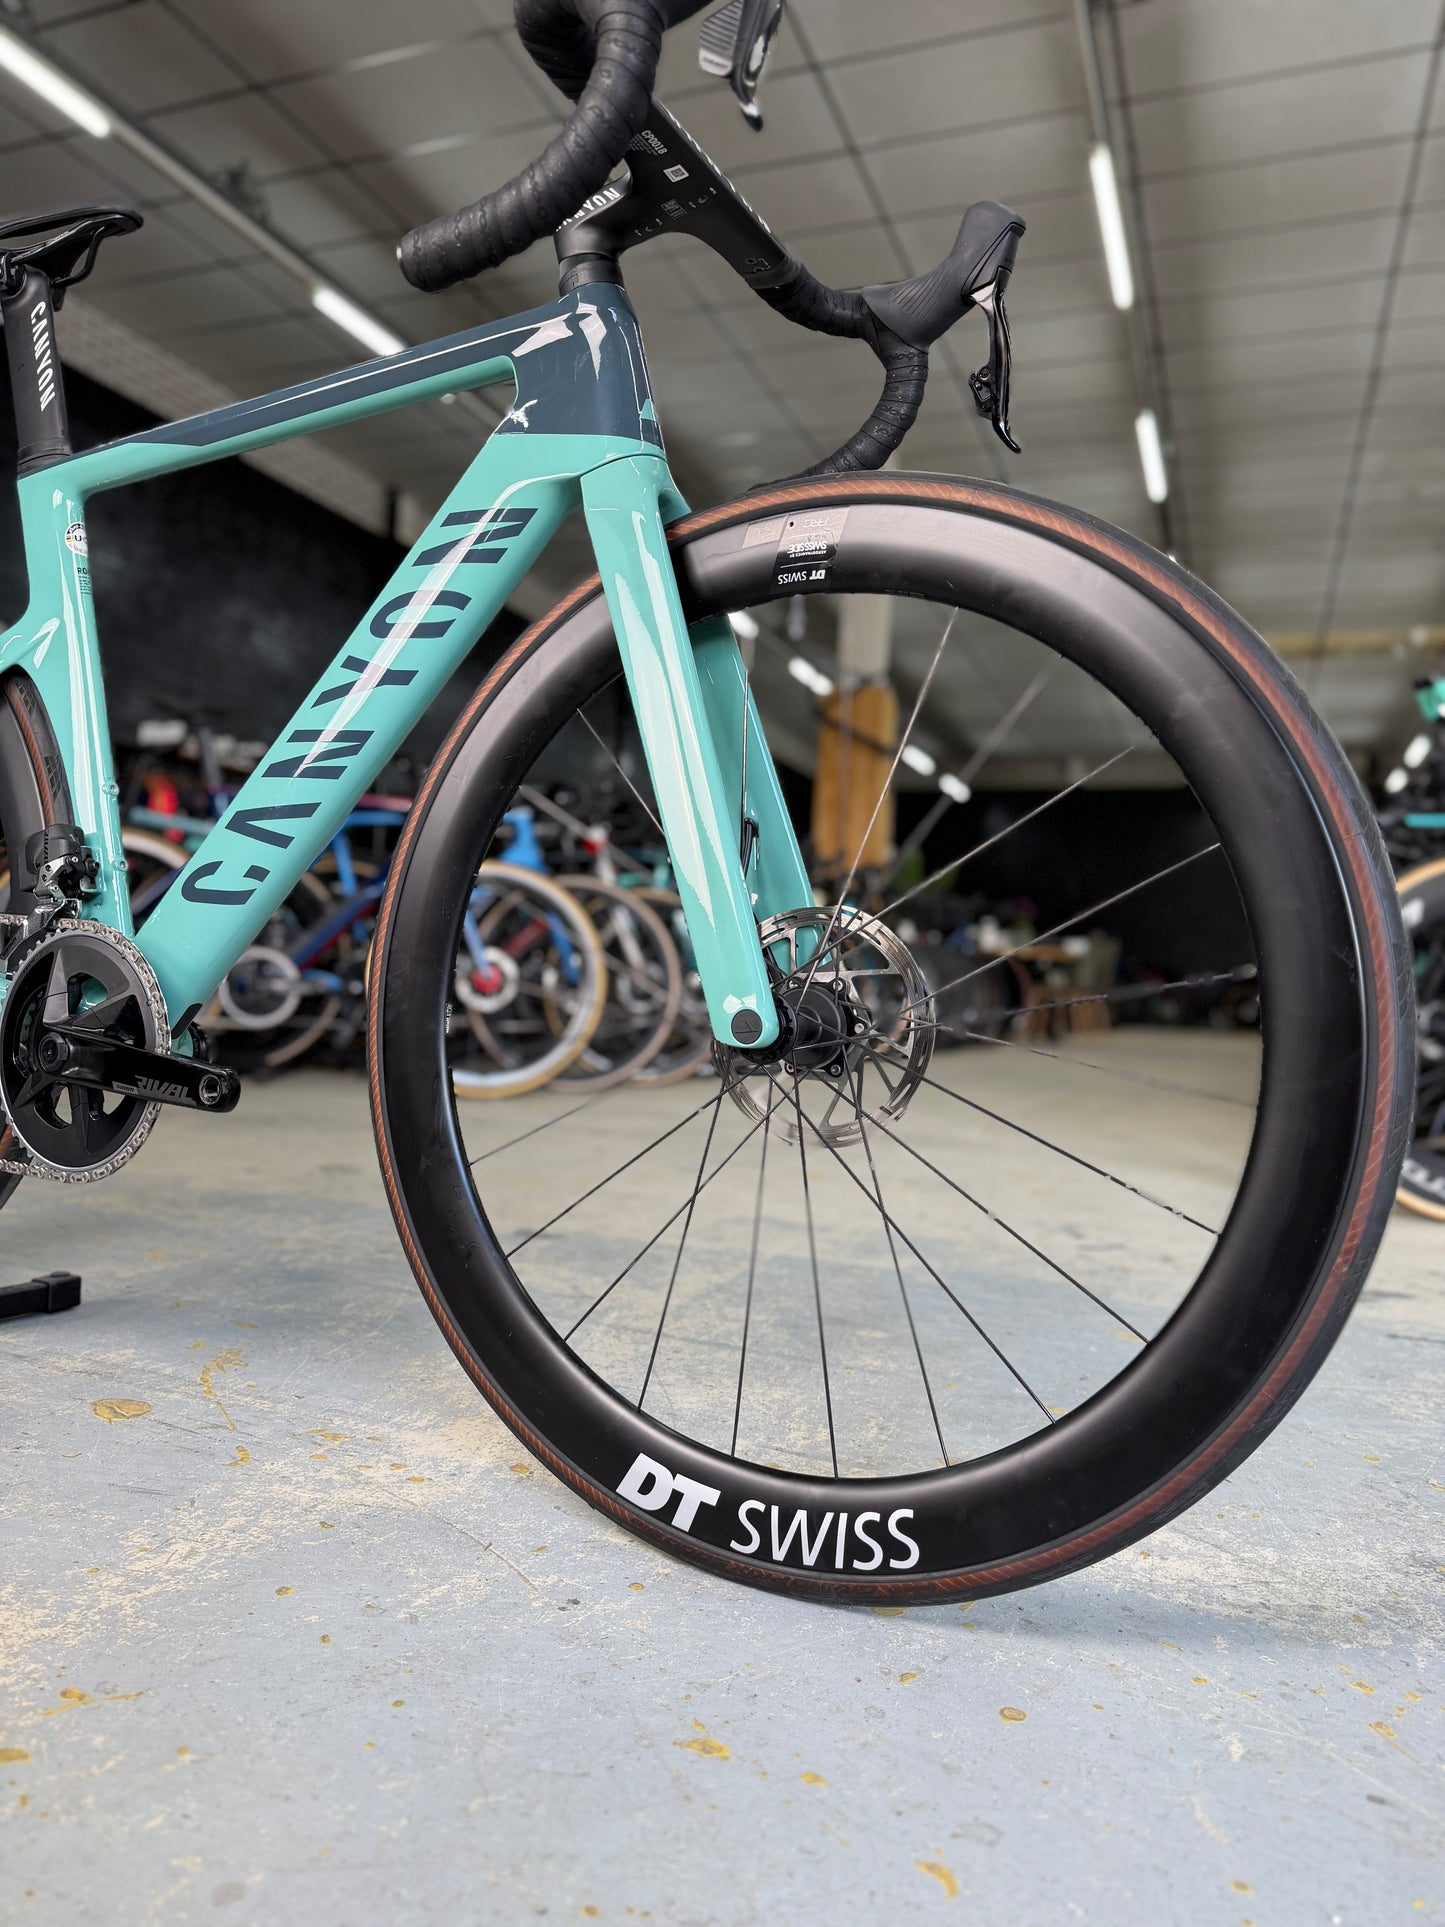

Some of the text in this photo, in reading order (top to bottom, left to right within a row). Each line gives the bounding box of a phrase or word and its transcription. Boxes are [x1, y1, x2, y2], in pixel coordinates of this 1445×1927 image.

[641, 130, 667, 154] CP0018
[555, 187, 621, 232] YON
[31, 301, 55, 412] CANYON
[778, 569, 826, 585] DT SWISS
[181, 508, 539, 906] CANYON
[135, 1075, 194, 1103] RIVAL
[615, 1452, 920, 1571] DT SWISS
